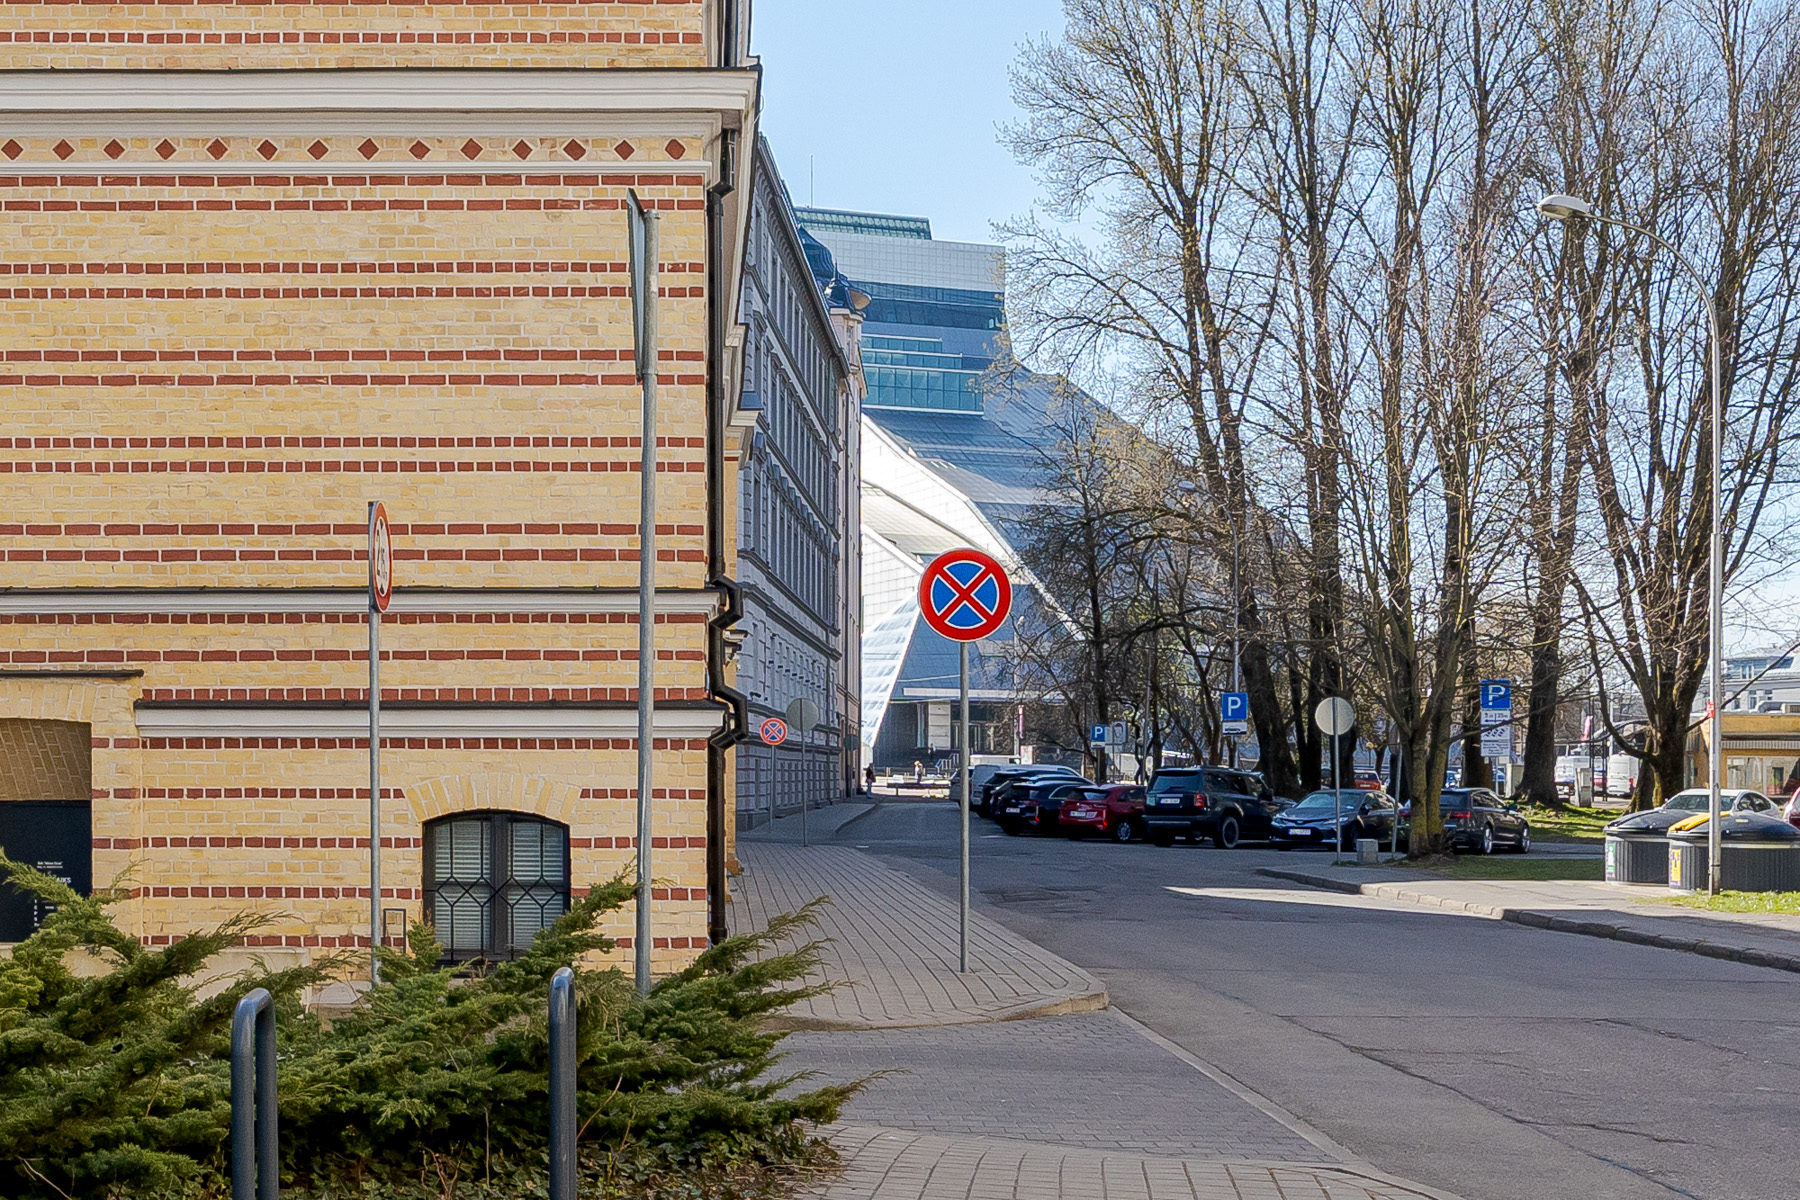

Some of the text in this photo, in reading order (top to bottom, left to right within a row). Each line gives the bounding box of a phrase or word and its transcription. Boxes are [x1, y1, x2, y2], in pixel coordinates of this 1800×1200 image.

[1488, 685, 1505, 705] P
[1228, 696, 1241, 716] P
[1094, 726, 1103, 738] P
